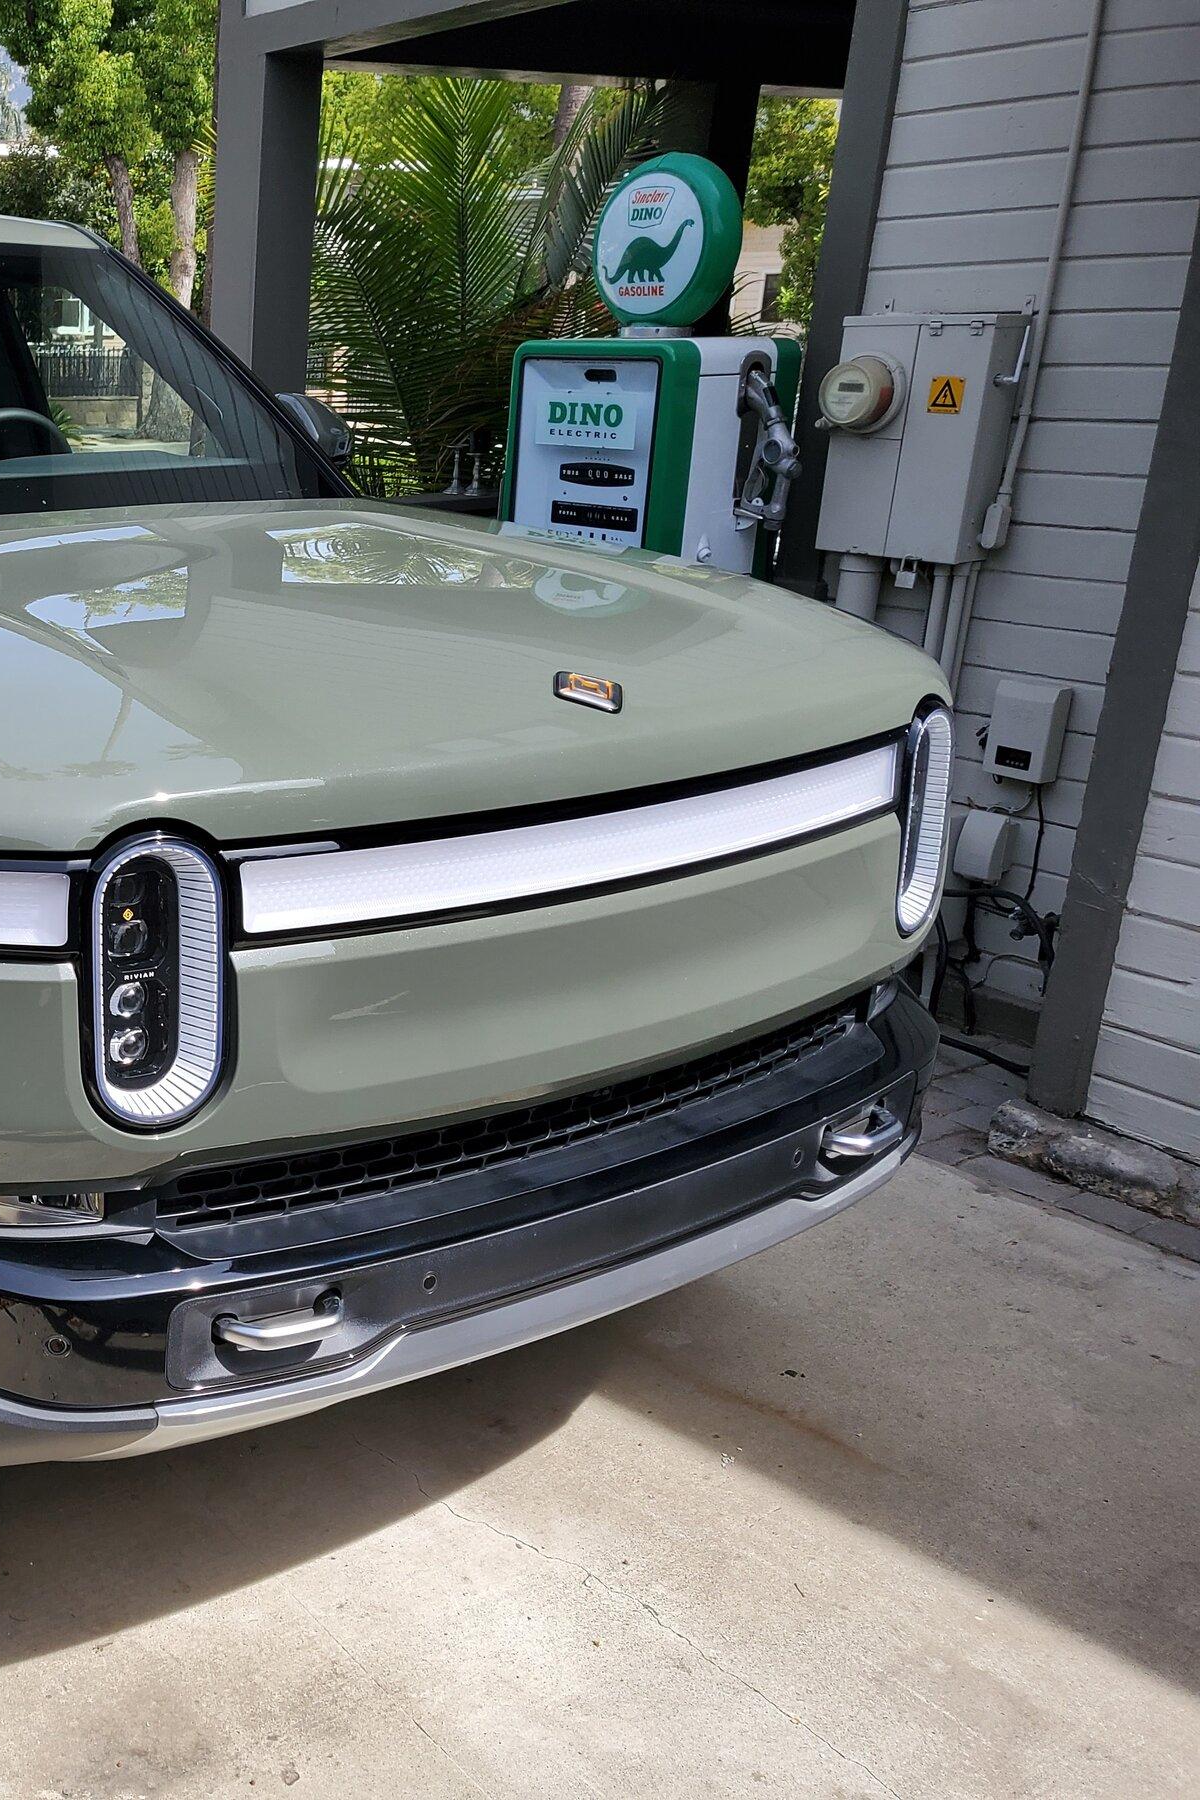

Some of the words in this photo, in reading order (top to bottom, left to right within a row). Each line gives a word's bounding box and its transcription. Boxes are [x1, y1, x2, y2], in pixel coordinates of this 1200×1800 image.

[632, 189, 669, 204] Sinclair
[630, 207, 663, 221] DINO
[619, 285, 664, 296] GASOLINE
[547, 401, 624, 428] DINO
[549, 428, 617, 440] ELECTRIC
[124, 971, 155, 980] RIVIAN
